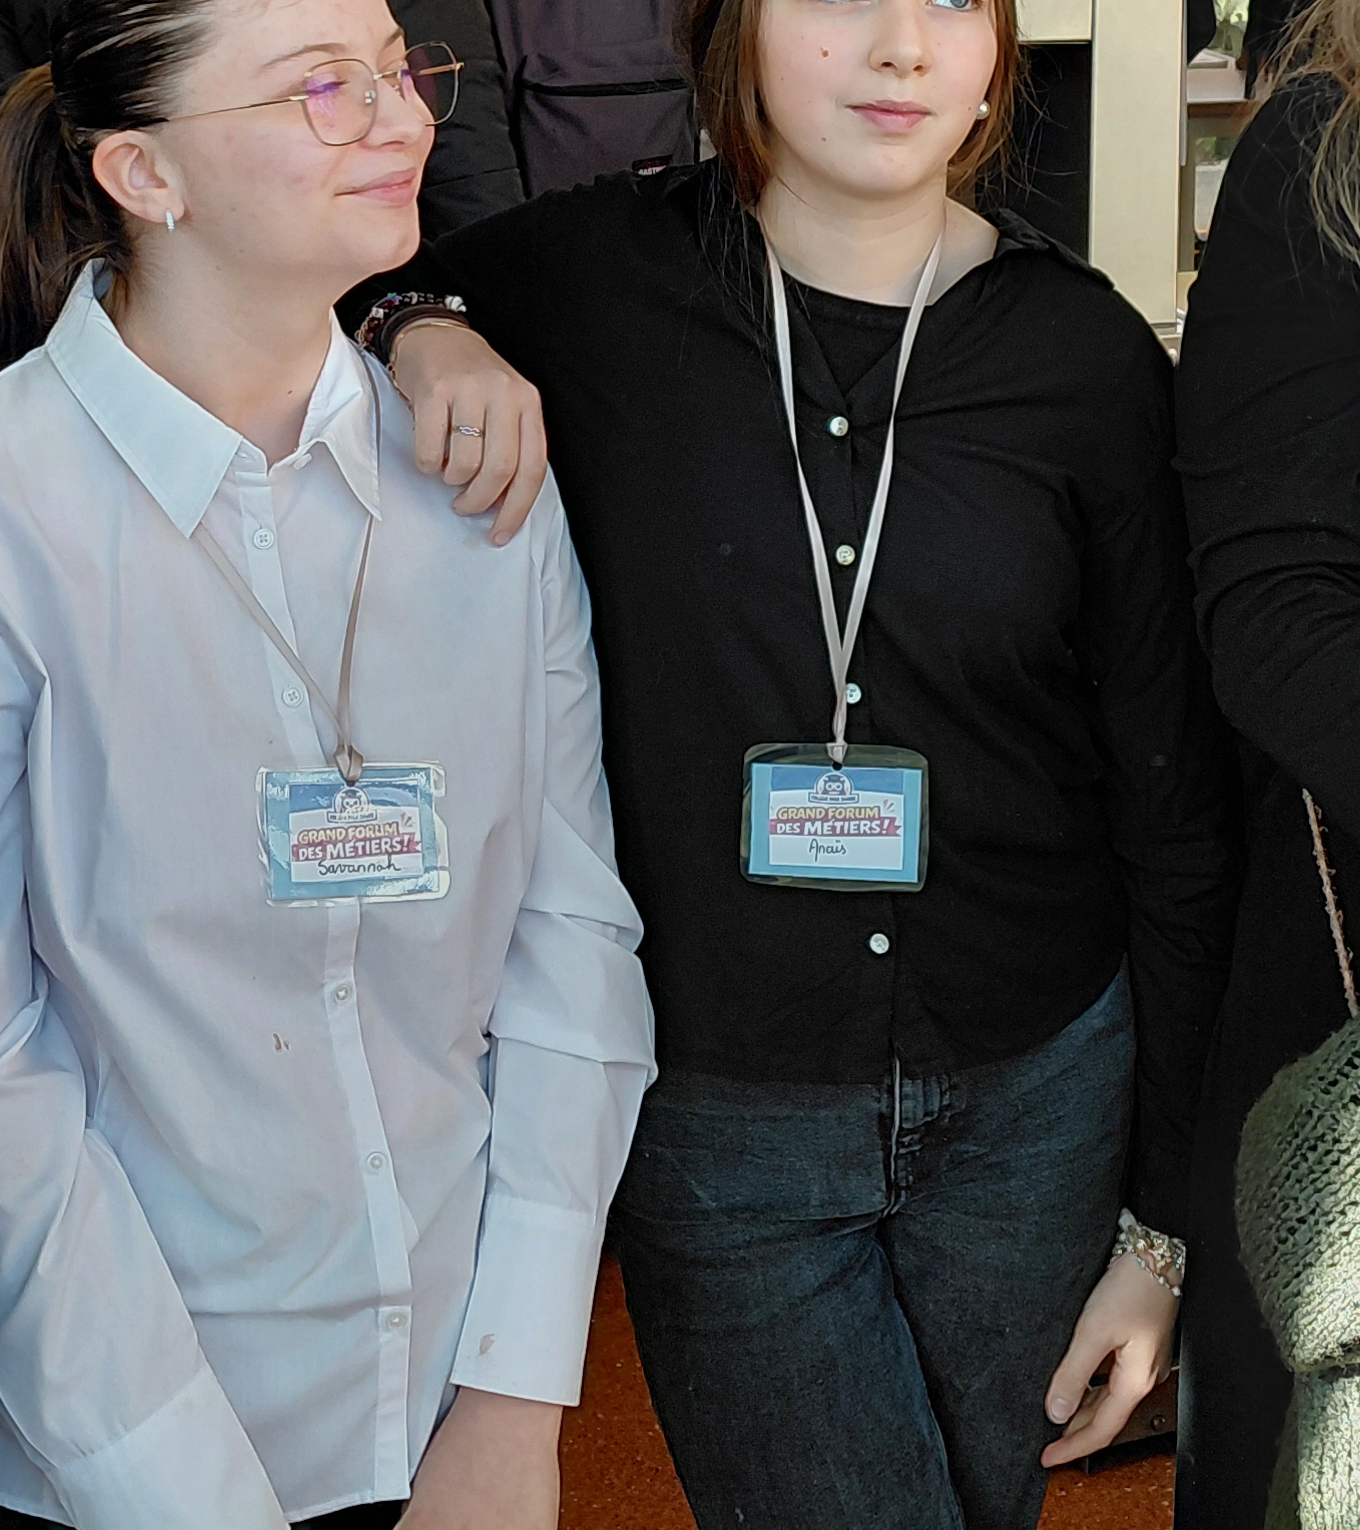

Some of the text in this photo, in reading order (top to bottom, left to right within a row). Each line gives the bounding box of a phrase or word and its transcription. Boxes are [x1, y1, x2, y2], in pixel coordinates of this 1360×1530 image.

[778, 807, 879, 820] GRAND FORUM
[298, 822, 399, 845] GRAND FORUM
[776, 822, 801, 834] DES
[298, 846, 323, 861] DES
[809, 838, 847, 863] Anaïs
[318, 854, 401, 876] Savannah
